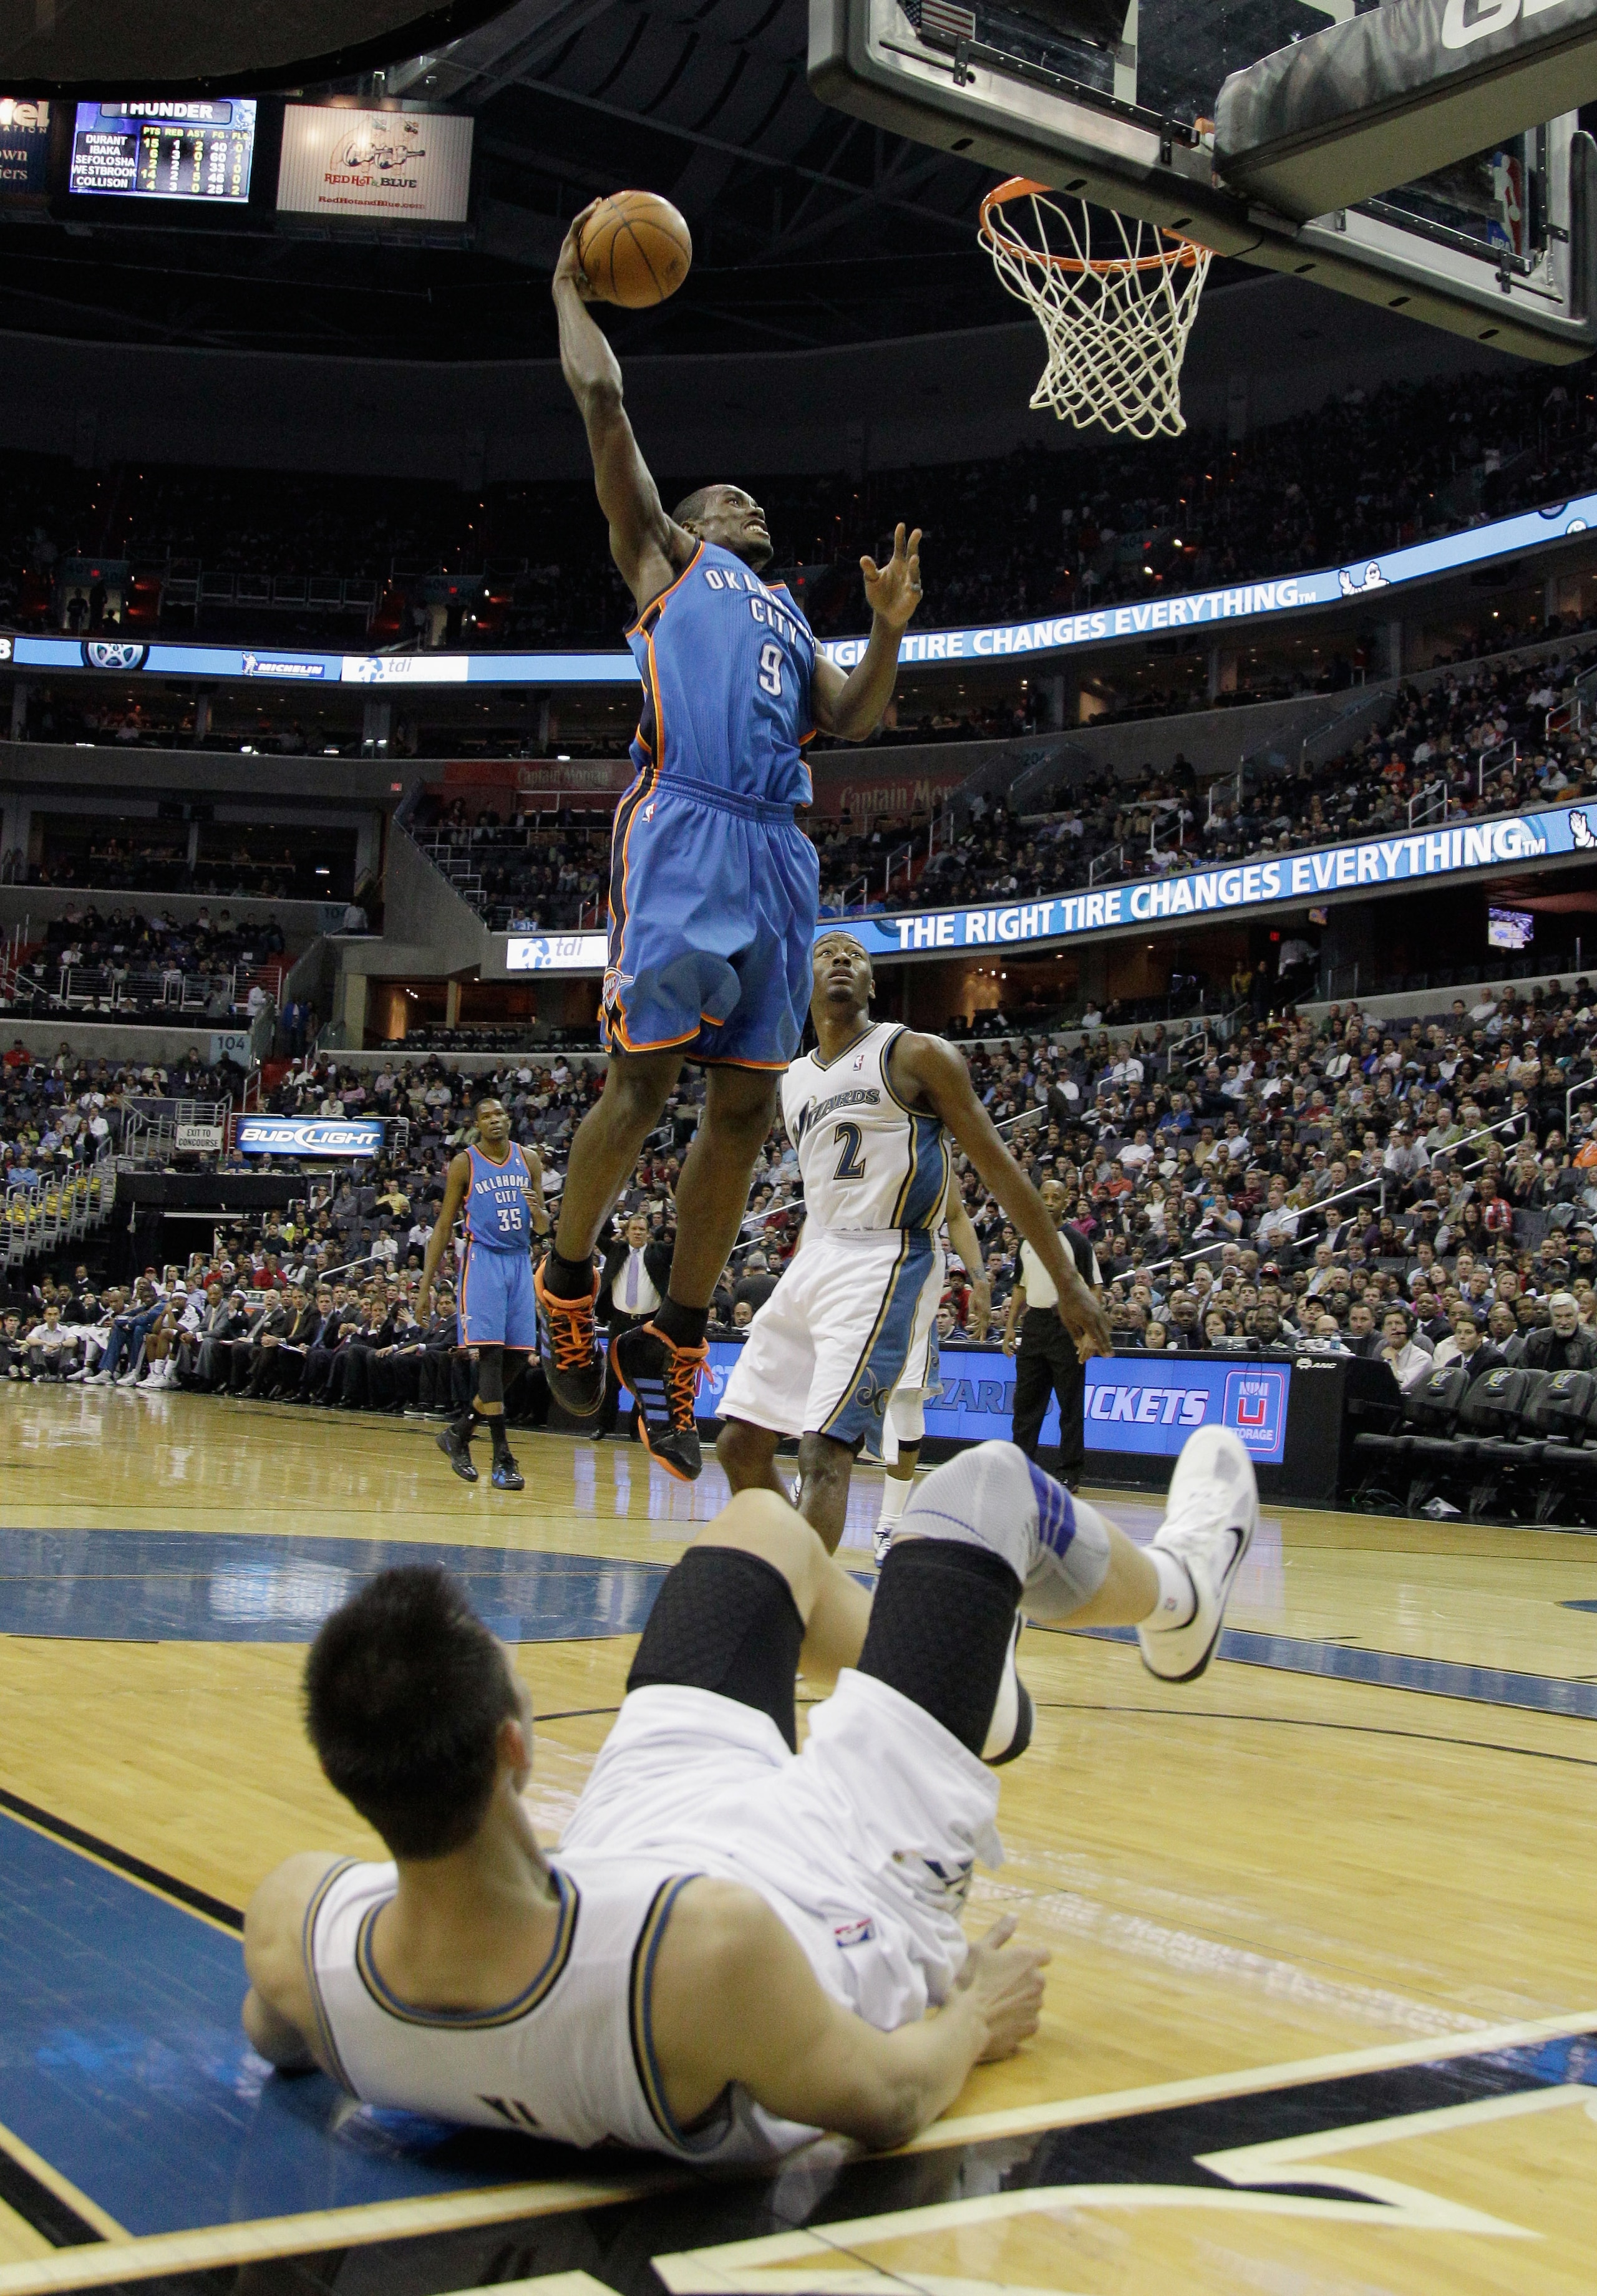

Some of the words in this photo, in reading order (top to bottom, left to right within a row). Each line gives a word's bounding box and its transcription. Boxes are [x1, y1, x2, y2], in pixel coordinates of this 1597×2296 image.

[143, 127, 161, 135] PTS
[165, 127, 183, 137] REB
[187, 129, 206, 138] AST
[231, 132, 249, 141] FLS
[85, 134, 128, 146] DURANT
[143, 138, 159, 148] 15
[173, 140, 180, 149] 1
[195, 142, 203, 151] 2
[210, 143, 227, 152] 40
[236, 143, 243, 153] 0
[89, 145, 122, 156] IBAKA
[150, 149, 158, 158] 6
[172, 150, 180, 160] 3
[194, 152, 203, 161] 0
[210, 153, 226, 162] 60
[235, 154, 241, 163] 1
[75, 155, 136, 167] SEFOLOSHA
[149, 159, 157, 168] 2
[170, 161, 180, 170] 2
[194, 162, 201, 172] 1
[209, 163, 225, 172] 33
[233, 165, 241, 173] 0
[72, 164, 137, 177] WESTBROOK
[141, 169, 157, 179] 14
[170, 171, 178, 180] 2
[192, 172, 201, 182] 5
[207, 173, 224, 183] 46
[233, 174, 241, 183] 0
[324, 173, 350, 185] RED
[380, 177, 417, 188] BLUE
[76, 177, 128, 188] COLLISON
[146, 181, 156, 191] 4
[169, 182, 178, 191] 3
[192, 183, 200, 193] 0
[207, 185, 224, 195] 25
[231, 186, 240, 195] 2
[318, 196, 425, 209] RedHotandBlue.com
[750, 596, 797, 646] CITY
[901, 632, 963, 661] TIRE
[973, 612, 1106, 655] CHANGES
[1114, 579, 1298, 634] EVERYTHING
[258, 663, 323, 674] MICHELIN
[388, 657, 412, 672] tdi
[759, 642, 783, 697] 9
[895, 914, 956, 949] THE
[965, 902, 1055, 944] RIGHT
[1061, 890, 1122, 931] TIRE
[1130, 861, 1281, 919] CHANGES
[1291, 819, 1524, 894] EVERYTHING
[556, 937, 583, 956] tdi
[218, 1035, 245, 1050] 104
[792, 1088, 880, 1151] WIZARDS
[187, 1128, 200, 1136] EXIT
[202, 1128, 211, 1137] TO
[240, 1128, 294, 1142] BUD
[306, 1132, 381, 1145] LIGHT
[178, 1138, 218, 1148] CONCOURSE
[833, 1121, 866, 1180] 2
[474, 1175, 530, 1195] OKLAHOMA
[494, 1189, 517, 1204] CITY
[497, 1208, 523, 1232] 35
[1238, 1381, 1269, 1397] MINI
